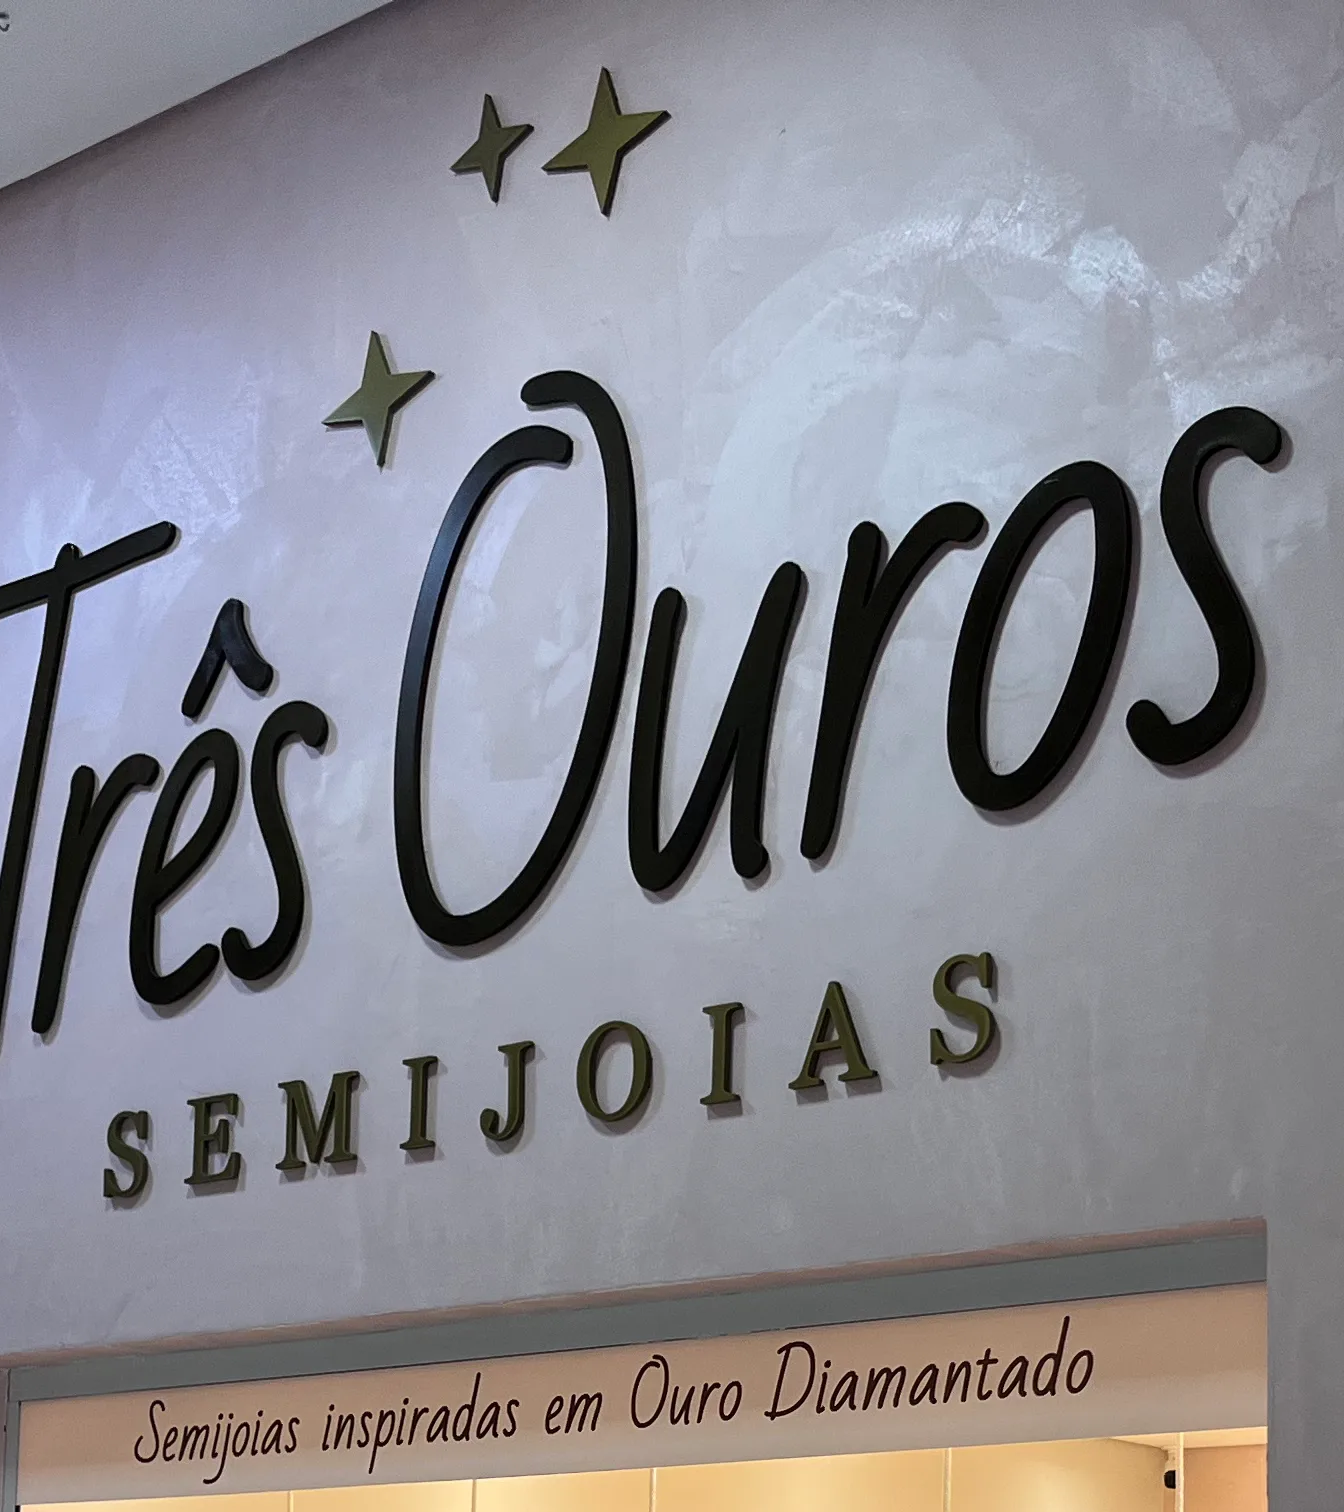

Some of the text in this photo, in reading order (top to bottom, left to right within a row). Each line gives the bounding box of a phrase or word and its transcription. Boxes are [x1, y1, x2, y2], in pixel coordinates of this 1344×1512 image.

[394, 369, 1283, 948] Ouros
[103, 952, 1000, 1204] SEMIJOIAS
[134, 1315, 1095, 1484] Semijoias inspiradas em Ouro Diamantado
